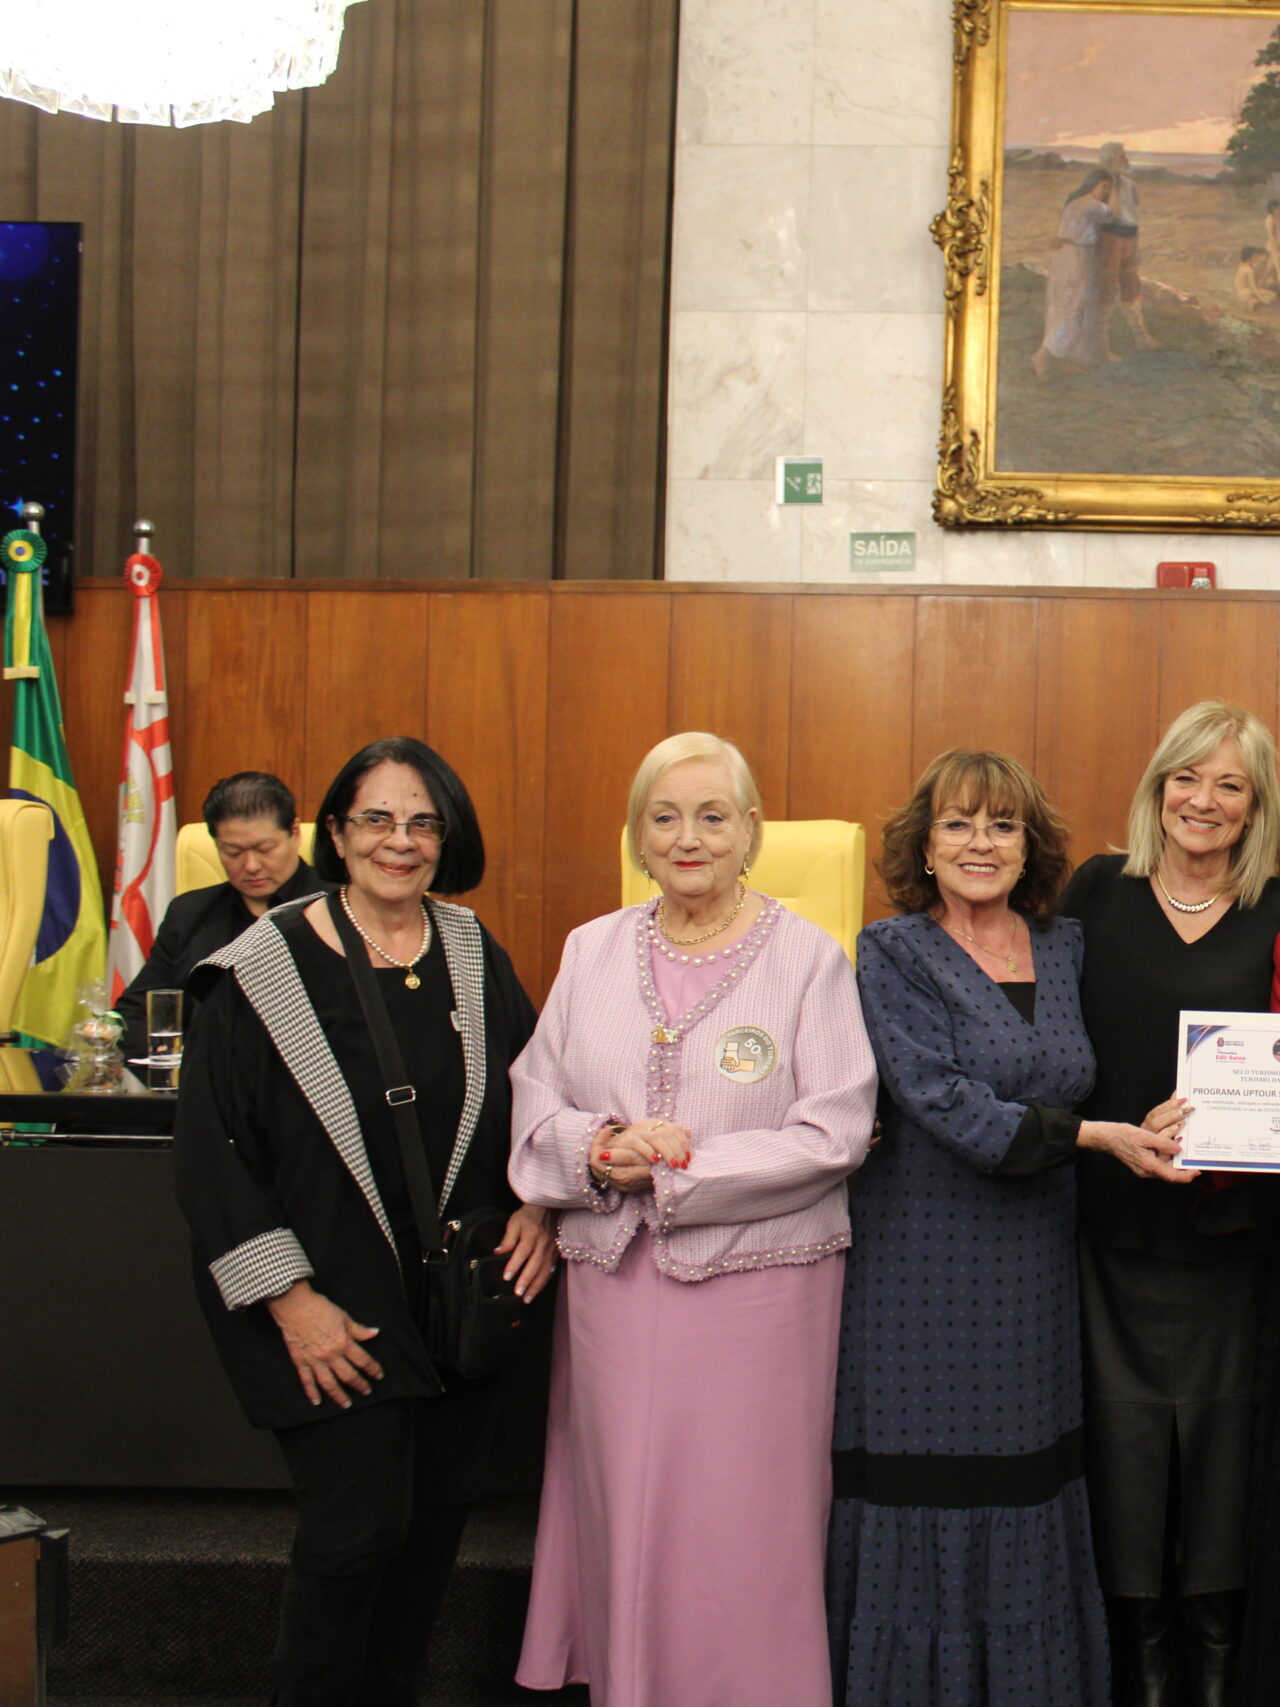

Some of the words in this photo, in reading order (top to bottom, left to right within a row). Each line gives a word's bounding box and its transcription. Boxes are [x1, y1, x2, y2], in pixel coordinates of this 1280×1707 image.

[854, 535, 912, 556] SAÍDA
[1193, 1088, 1241, 1097] PROGRAMA
[1243, 1089, 1276, 1098] UPTOUR
